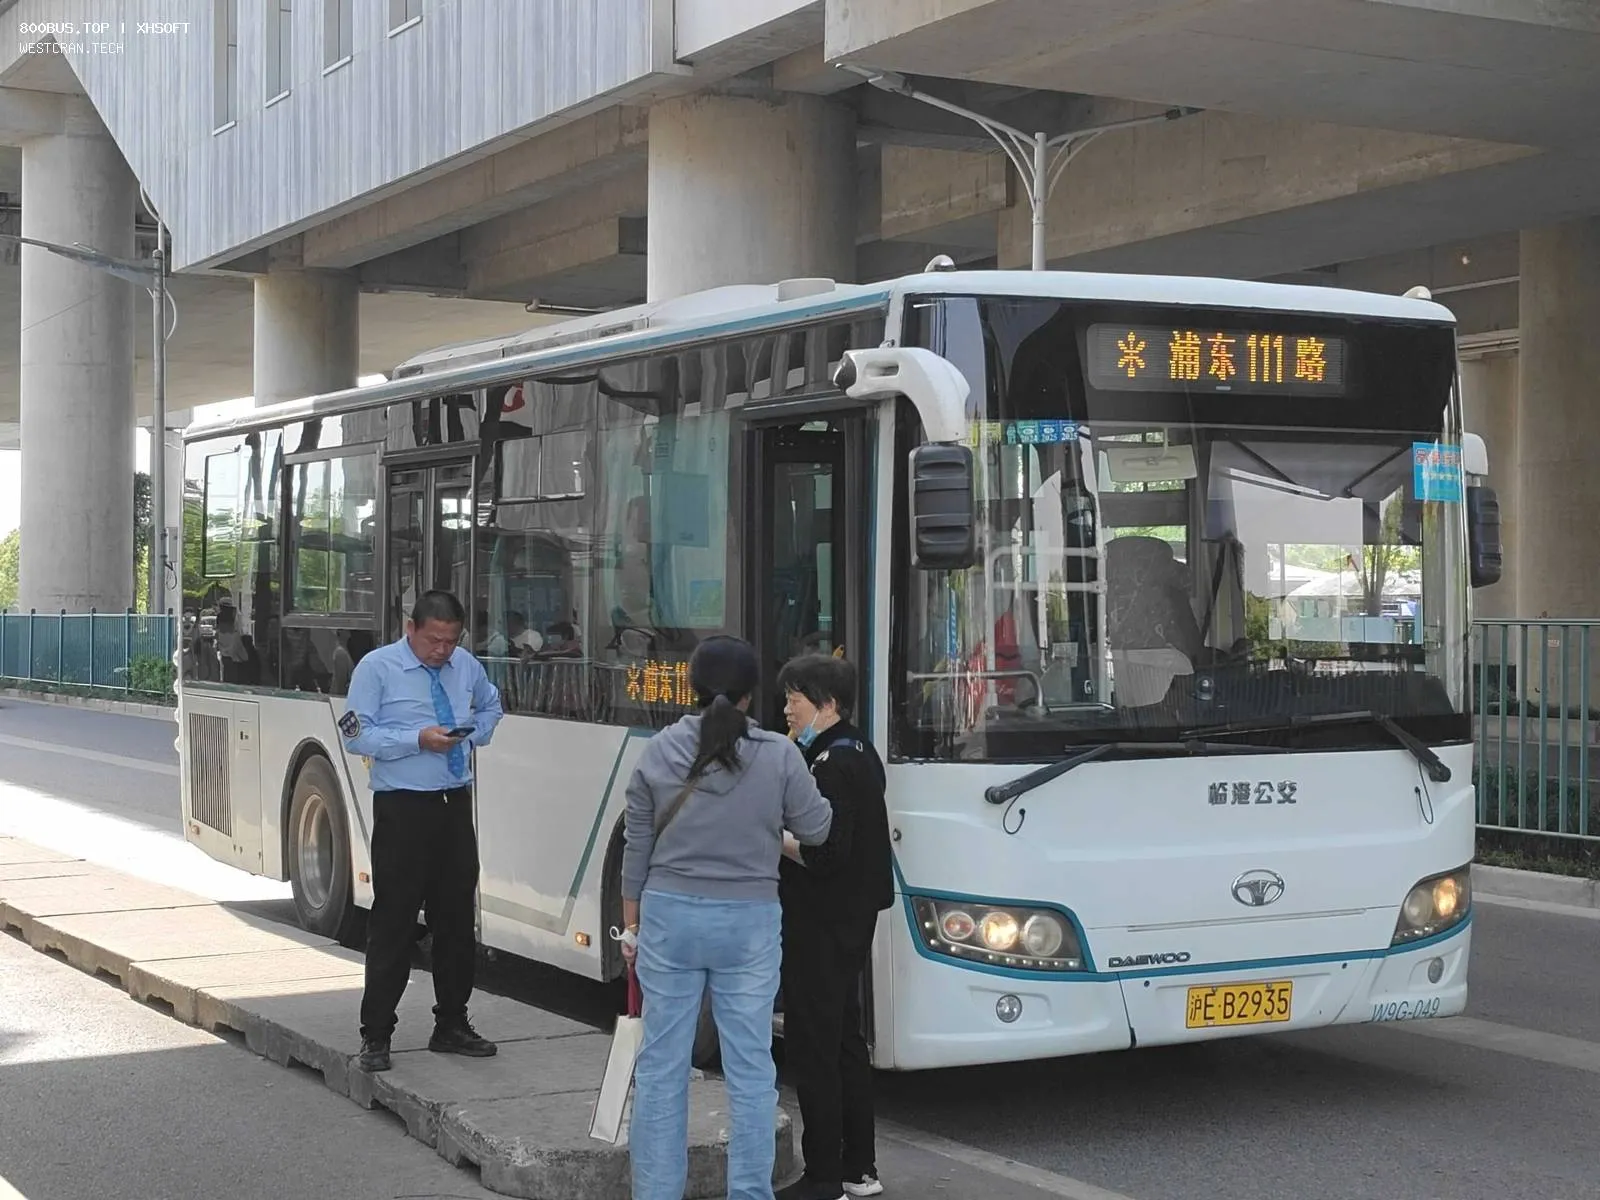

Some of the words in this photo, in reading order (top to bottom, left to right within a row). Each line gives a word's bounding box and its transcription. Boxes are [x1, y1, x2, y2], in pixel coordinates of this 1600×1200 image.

[1208, 780, 1297, 805] 临港公交
[1108, 952, 1191, 968] DAEWOO
[1371, 997, 1440, 1022] W9G-049
